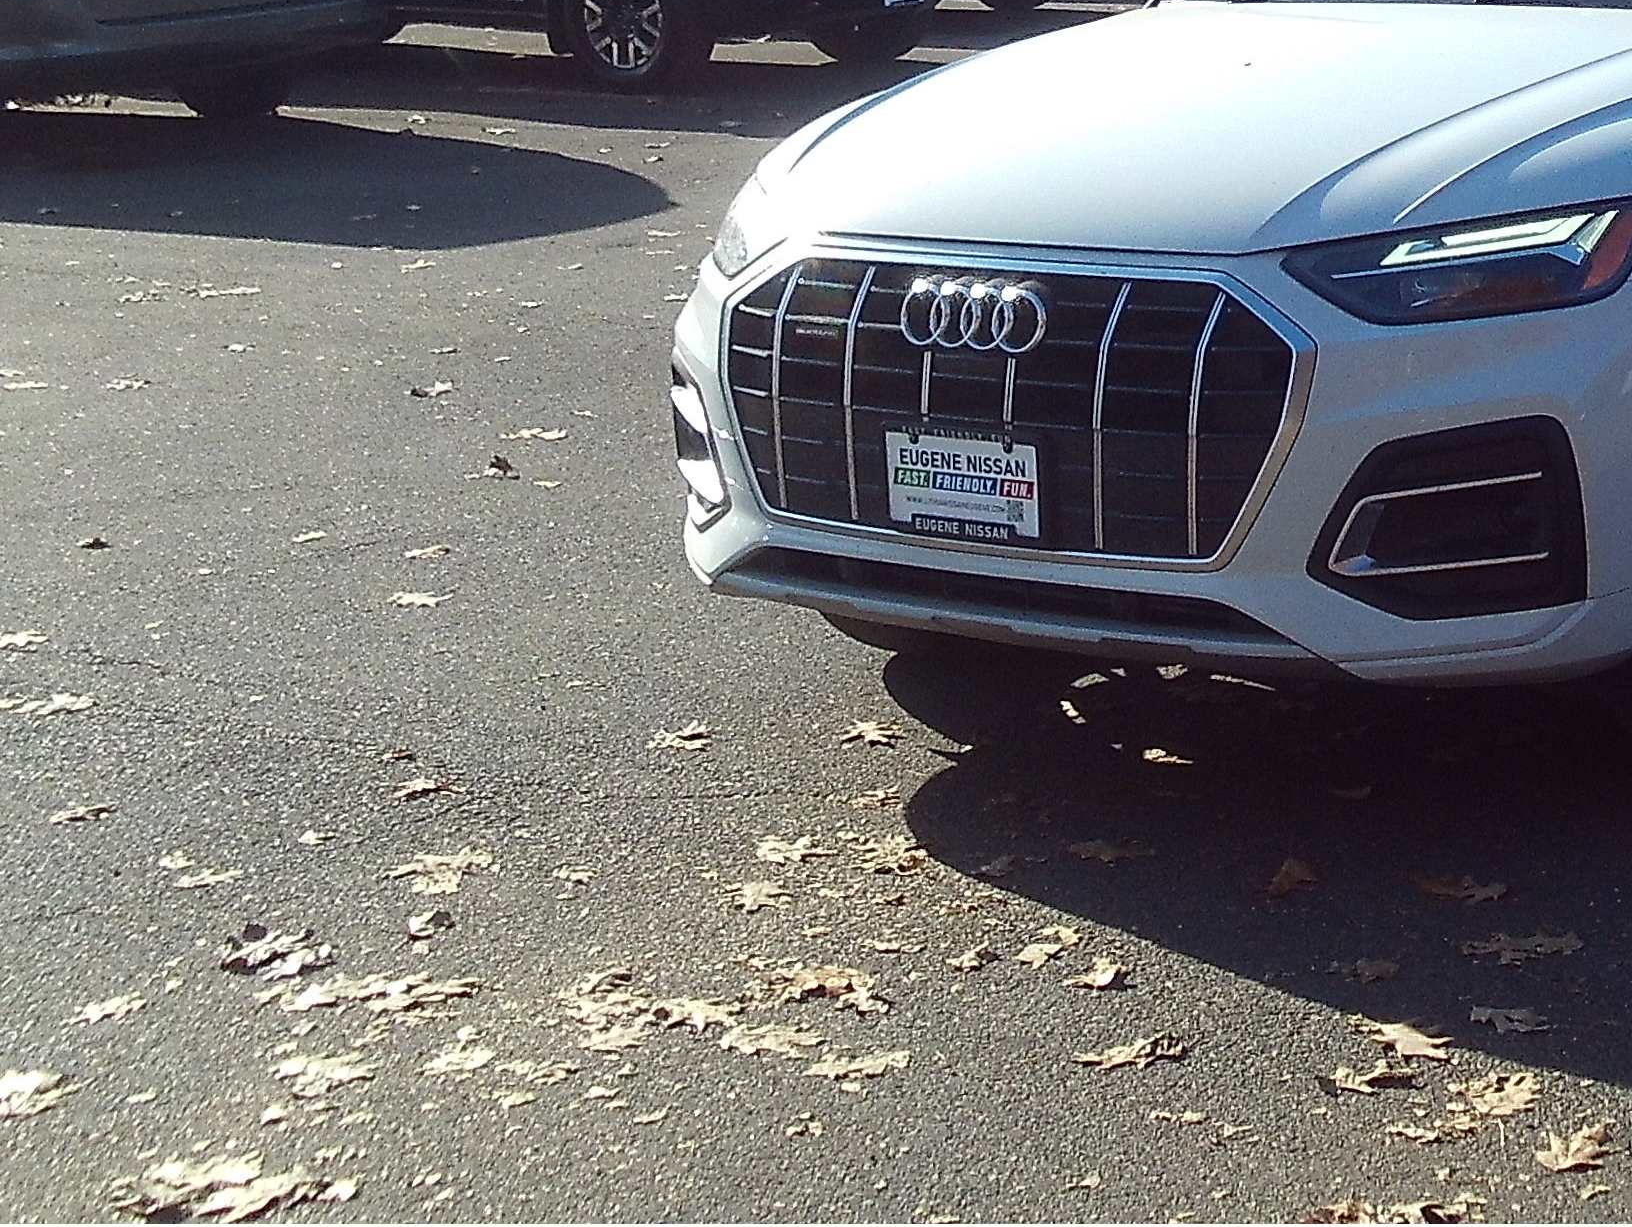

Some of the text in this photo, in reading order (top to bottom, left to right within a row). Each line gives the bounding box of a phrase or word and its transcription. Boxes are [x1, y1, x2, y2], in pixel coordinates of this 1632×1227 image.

[899, 447, 1026, 478] EUGENE NISSAN
[897, 470, 1031, 498] FAST. FRIENDLY. FUN.
[915, 517, 1009, 540] EUGENE NISSAN
